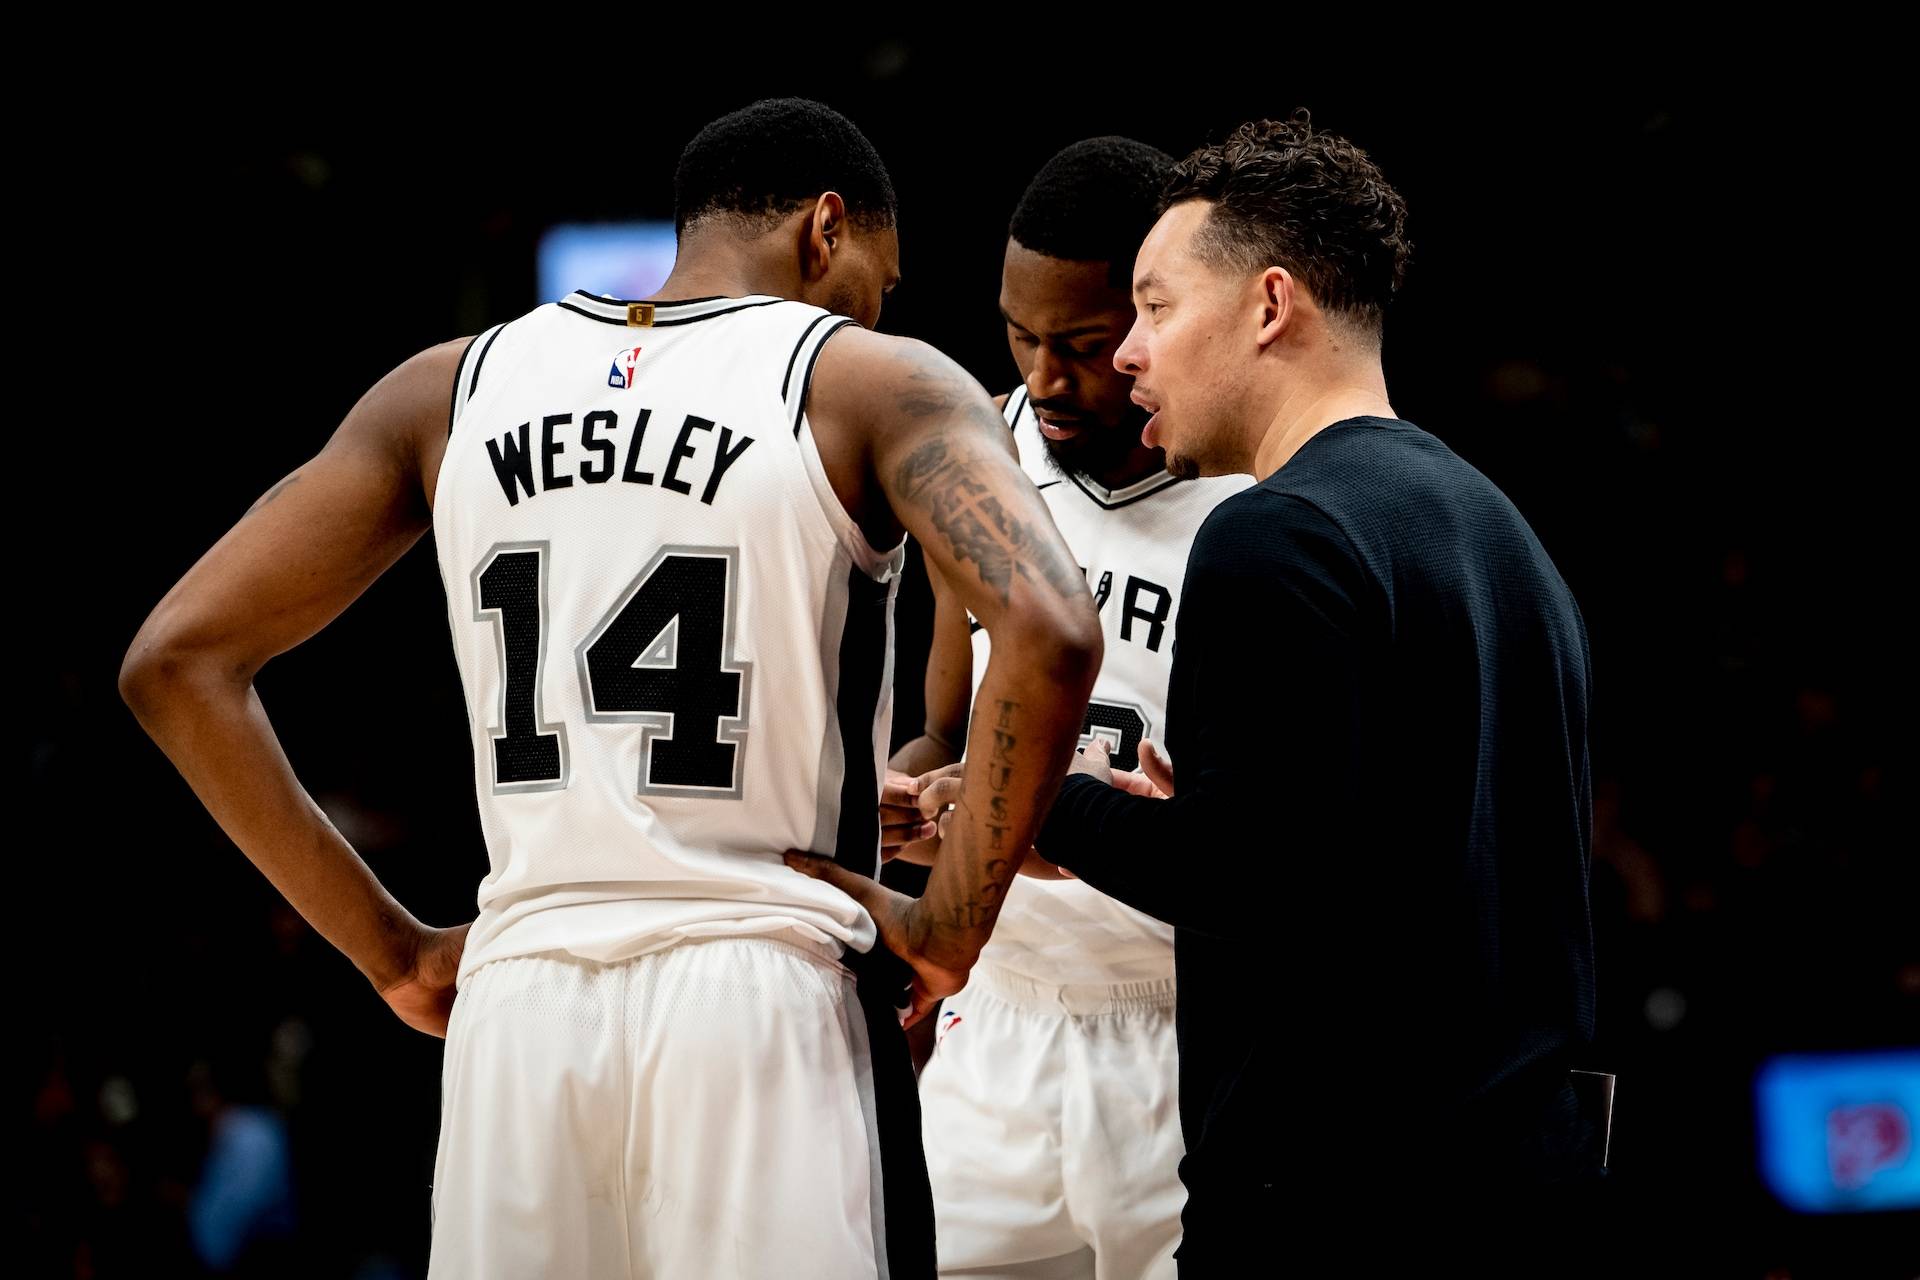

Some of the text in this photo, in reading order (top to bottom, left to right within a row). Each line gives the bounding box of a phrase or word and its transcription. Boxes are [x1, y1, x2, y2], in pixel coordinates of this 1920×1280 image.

[609, 374, 624, 386] NBA
[485, 408, 755, 506] WESLEY
[470, 540, 753, 800] 14
